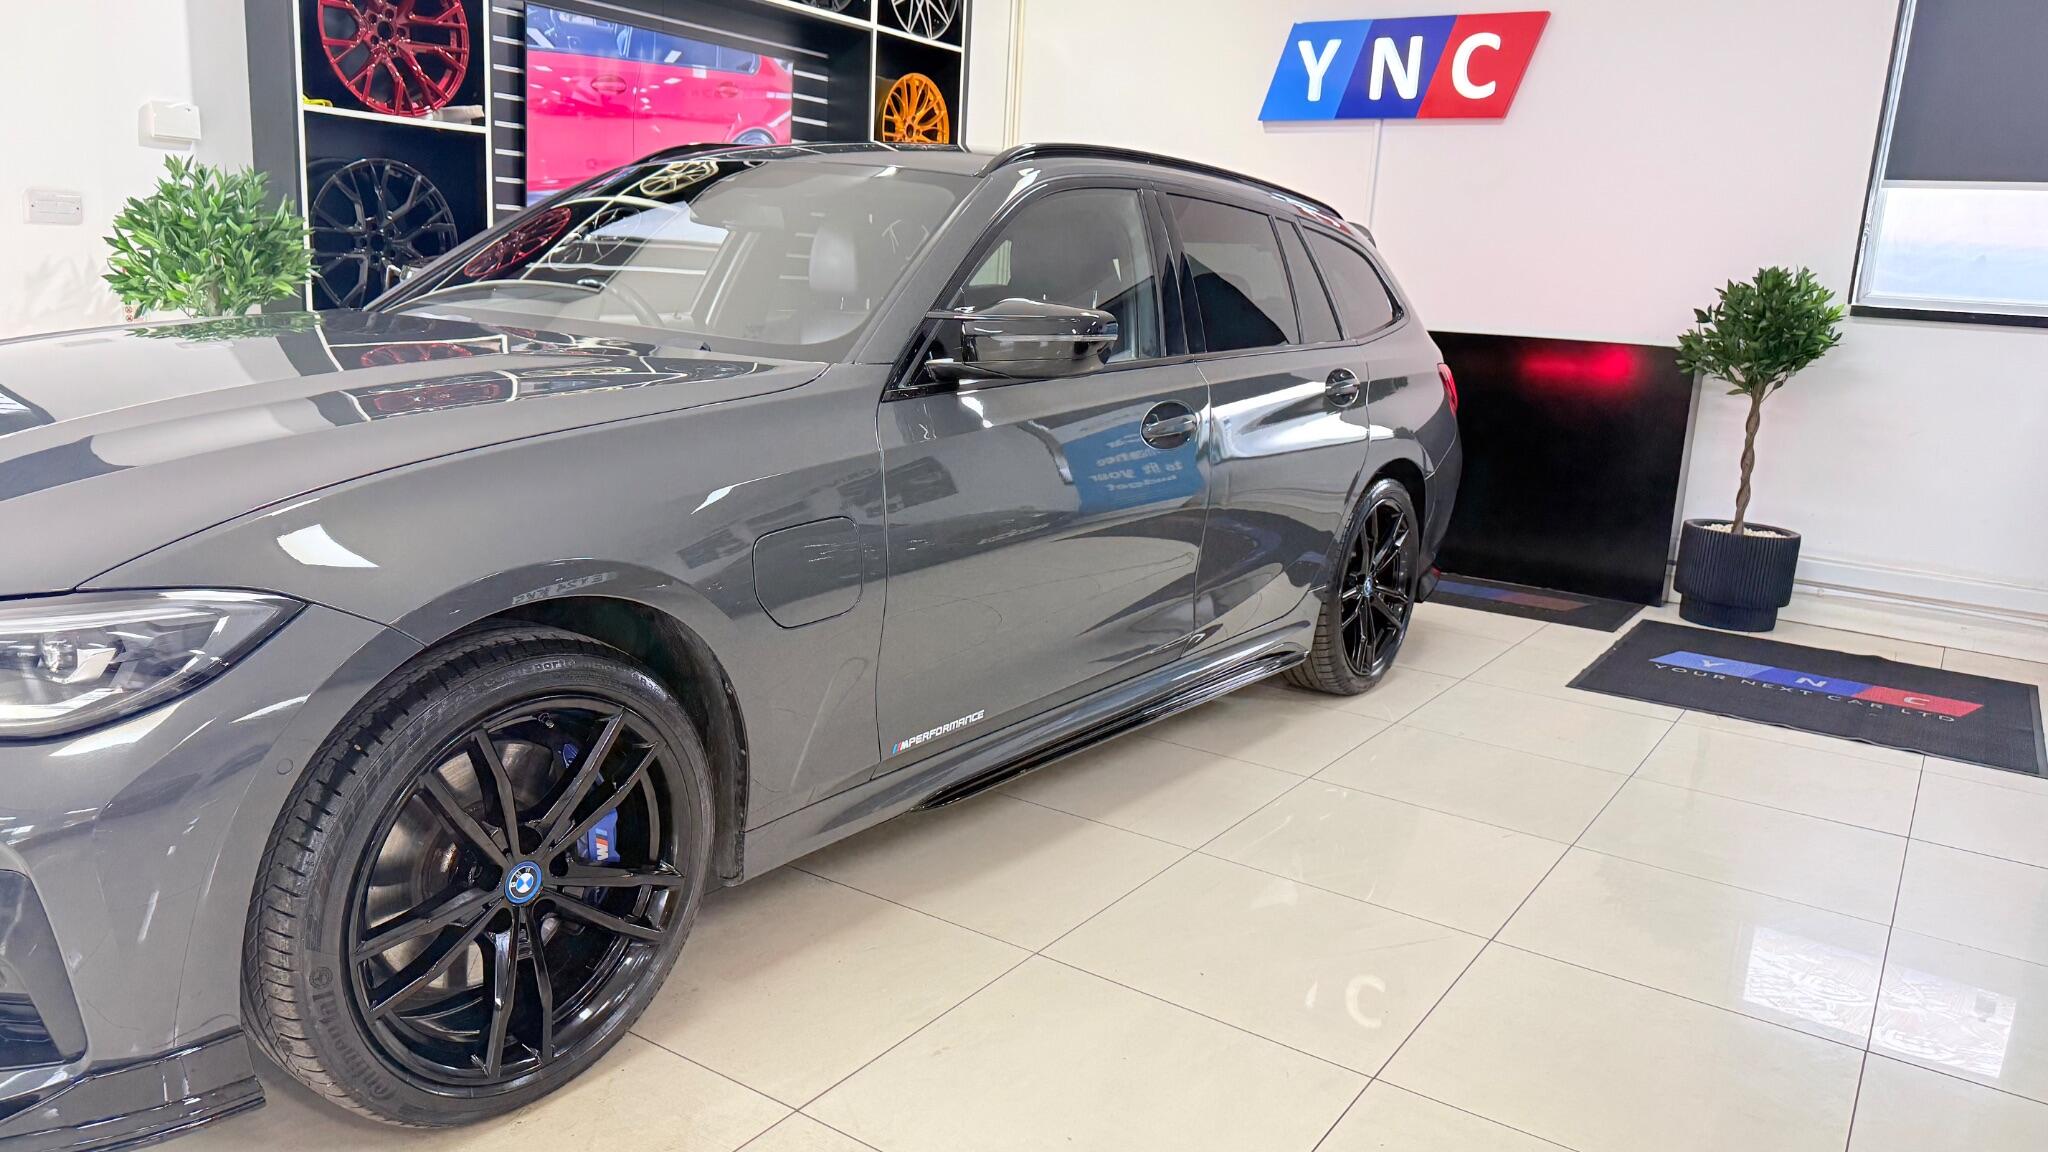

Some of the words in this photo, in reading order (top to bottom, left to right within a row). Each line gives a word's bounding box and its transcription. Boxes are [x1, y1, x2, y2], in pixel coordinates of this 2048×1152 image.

[1297, 32, 1502, 102] YNC
[1655, 663, 1726, 680] YOUR
[1741, 679, 1813, 696] NEXT
[1827, 695, 1884, 710] CAR
[1901, 708, 1956, 722] LTD
